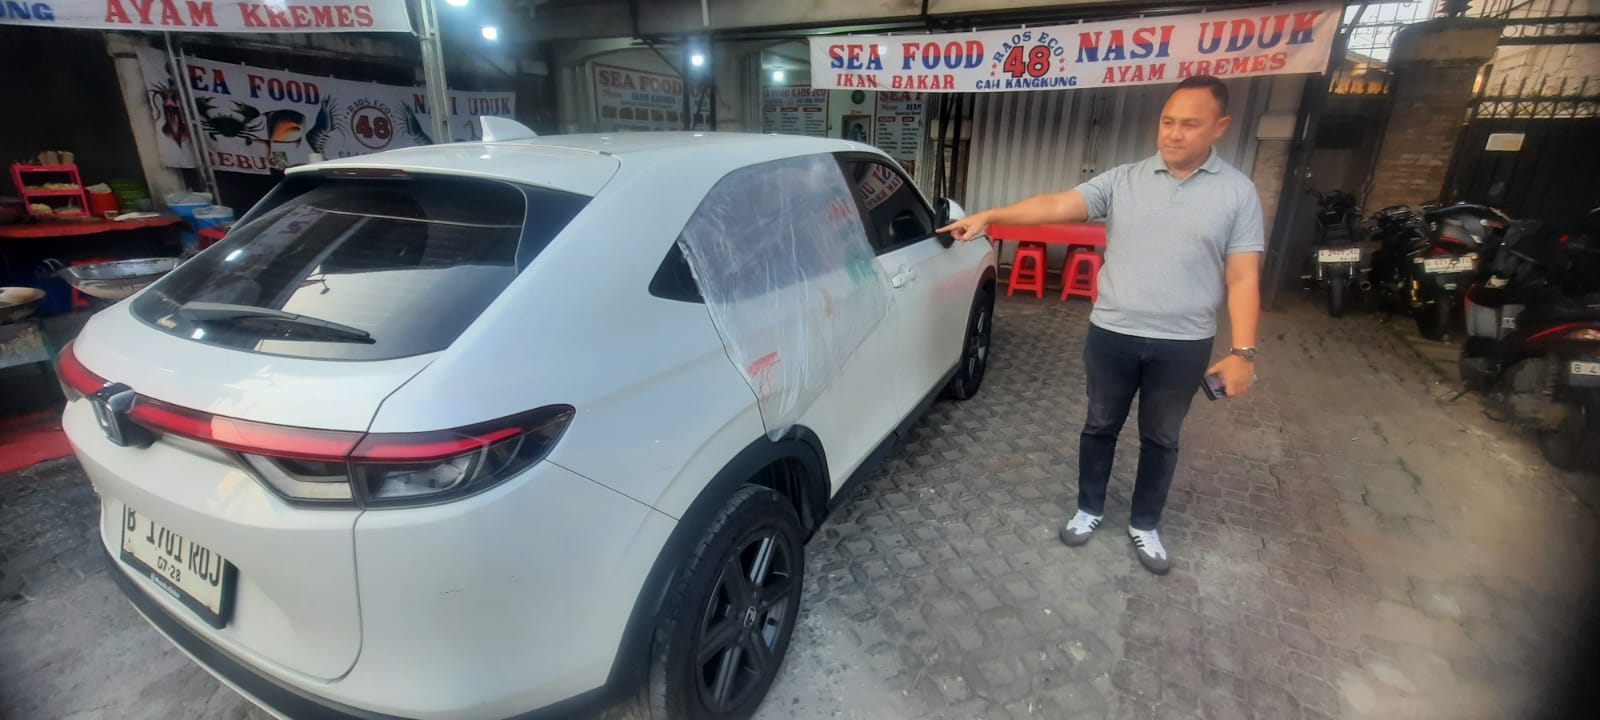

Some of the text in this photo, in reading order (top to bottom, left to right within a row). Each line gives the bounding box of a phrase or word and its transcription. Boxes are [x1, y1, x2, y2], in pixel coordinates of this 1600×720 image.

[0, 1, 54, 21] NG
[105, 0, 373, 28] AYAM KREMES
[993, 31, 1064, 63] RAOS ECO
[1075, 10, 1323, 63] NASI UDUK
[828, 40, 985, 71] SEA FOOD
[1003, 45, 1051, 78] 48
[1102, 52, 1287, 83] AYAM KREMES
[248, 74, 320, 105] FOOD
[599, 69, 634, 90] SEA
[836, 73, 955, 90] IKAN BAKAR
[975, 76, 1078, 90] CAH KANGKUNG
[468, 96, 512, 116] UDUK
[355, 115, 390, 139] 48
[1575, 363, 1581, 373] B
